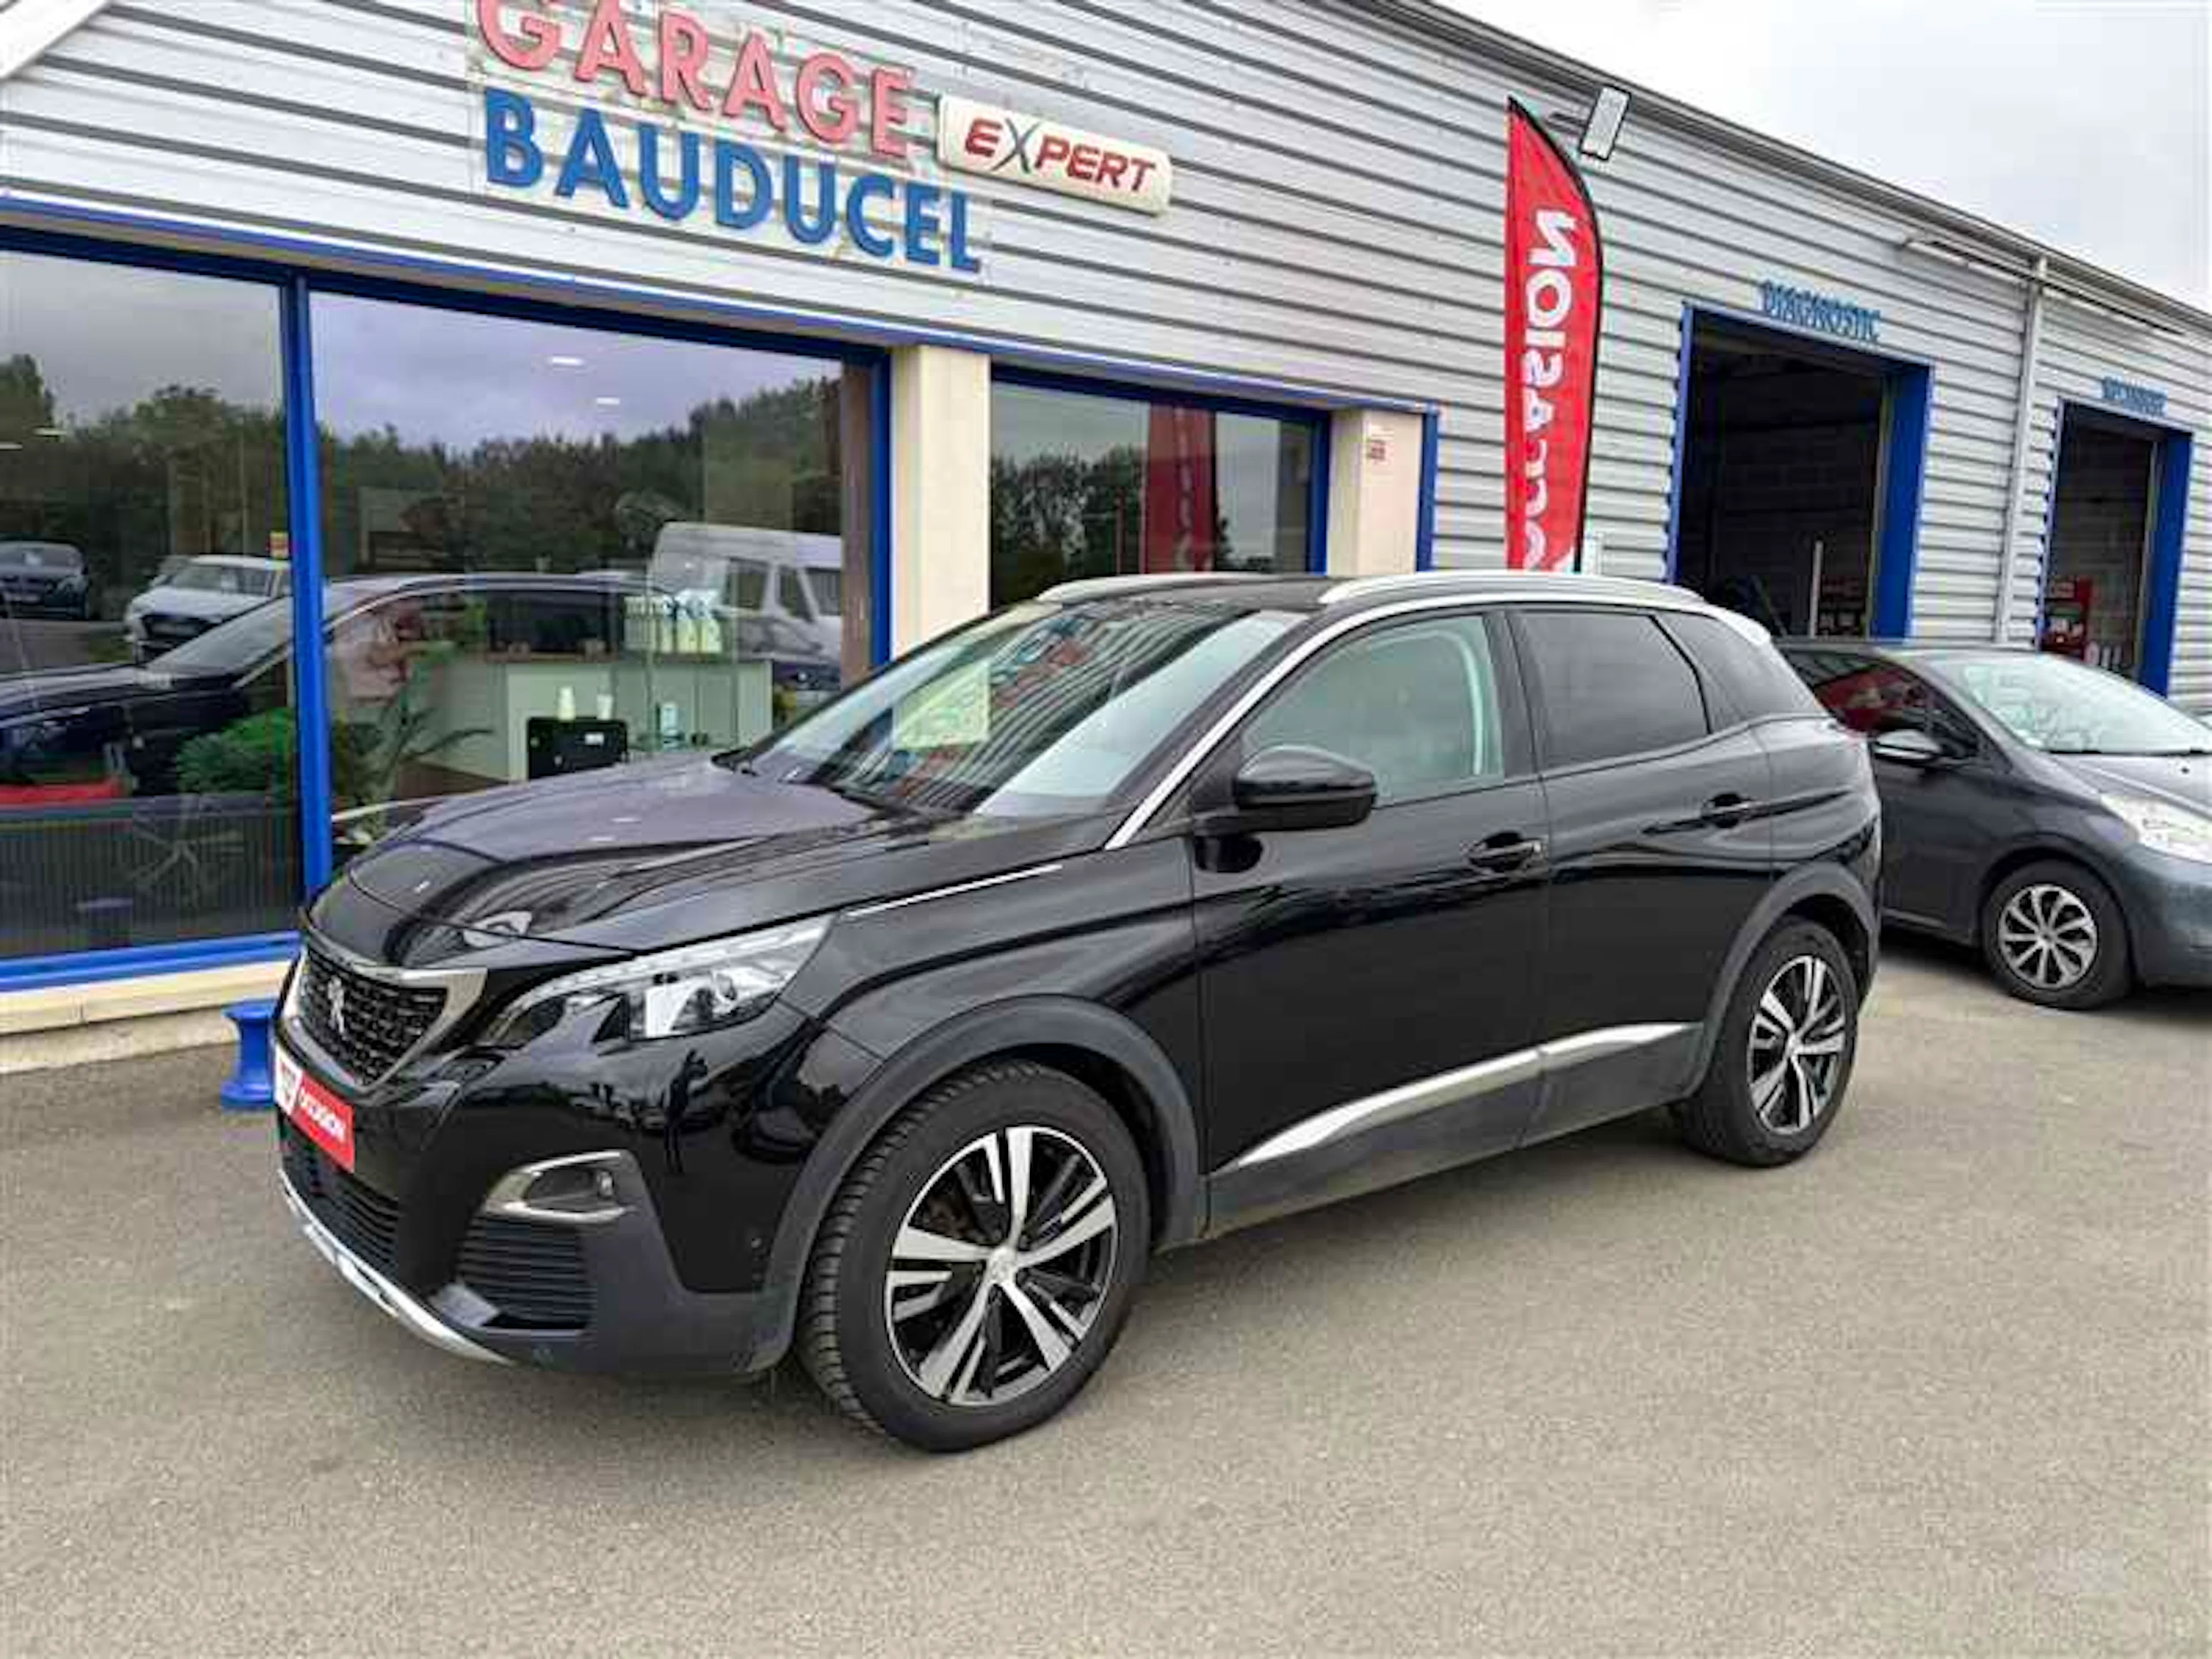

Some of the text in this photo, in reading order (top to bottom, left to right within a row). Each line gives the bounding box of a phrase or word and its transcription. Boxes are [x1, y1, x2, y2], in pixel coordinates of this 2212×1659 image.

[478, 0, 915, 158] GARAGE
[964, 117, 1156, 191] EXPERT
[484, 87, 982, 273] BAUDUCEL
